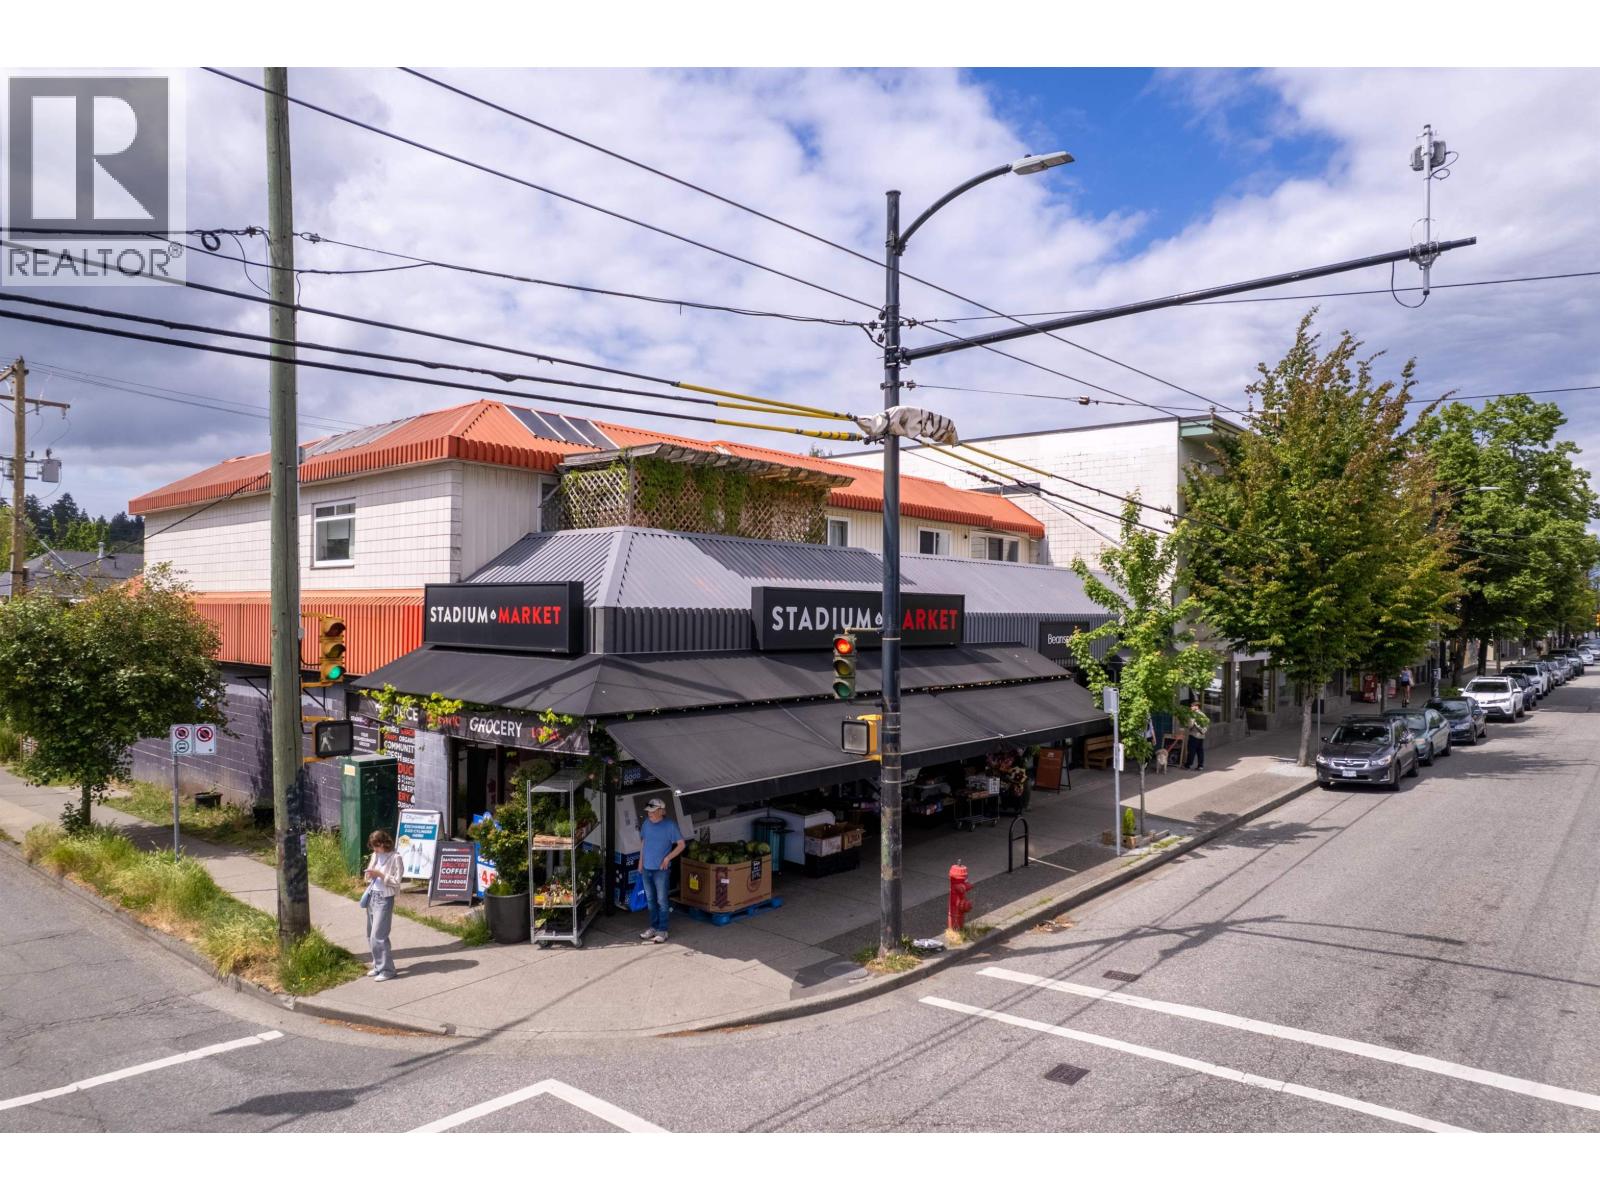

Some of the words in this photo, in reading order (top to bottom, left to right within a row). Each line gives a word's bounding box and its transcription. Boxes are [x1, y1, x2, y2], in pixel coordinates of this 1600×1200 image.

[430, 605, 489, 624] STADIUM
[498, 605, 561, 625] MARKET
[772, 605, 872, 632] STADIUM
[902, 608, 958, 631] ARKET
[469, 716, 523, 738] GROCERY
[384, 740, 414, 754] COMMUNIT
